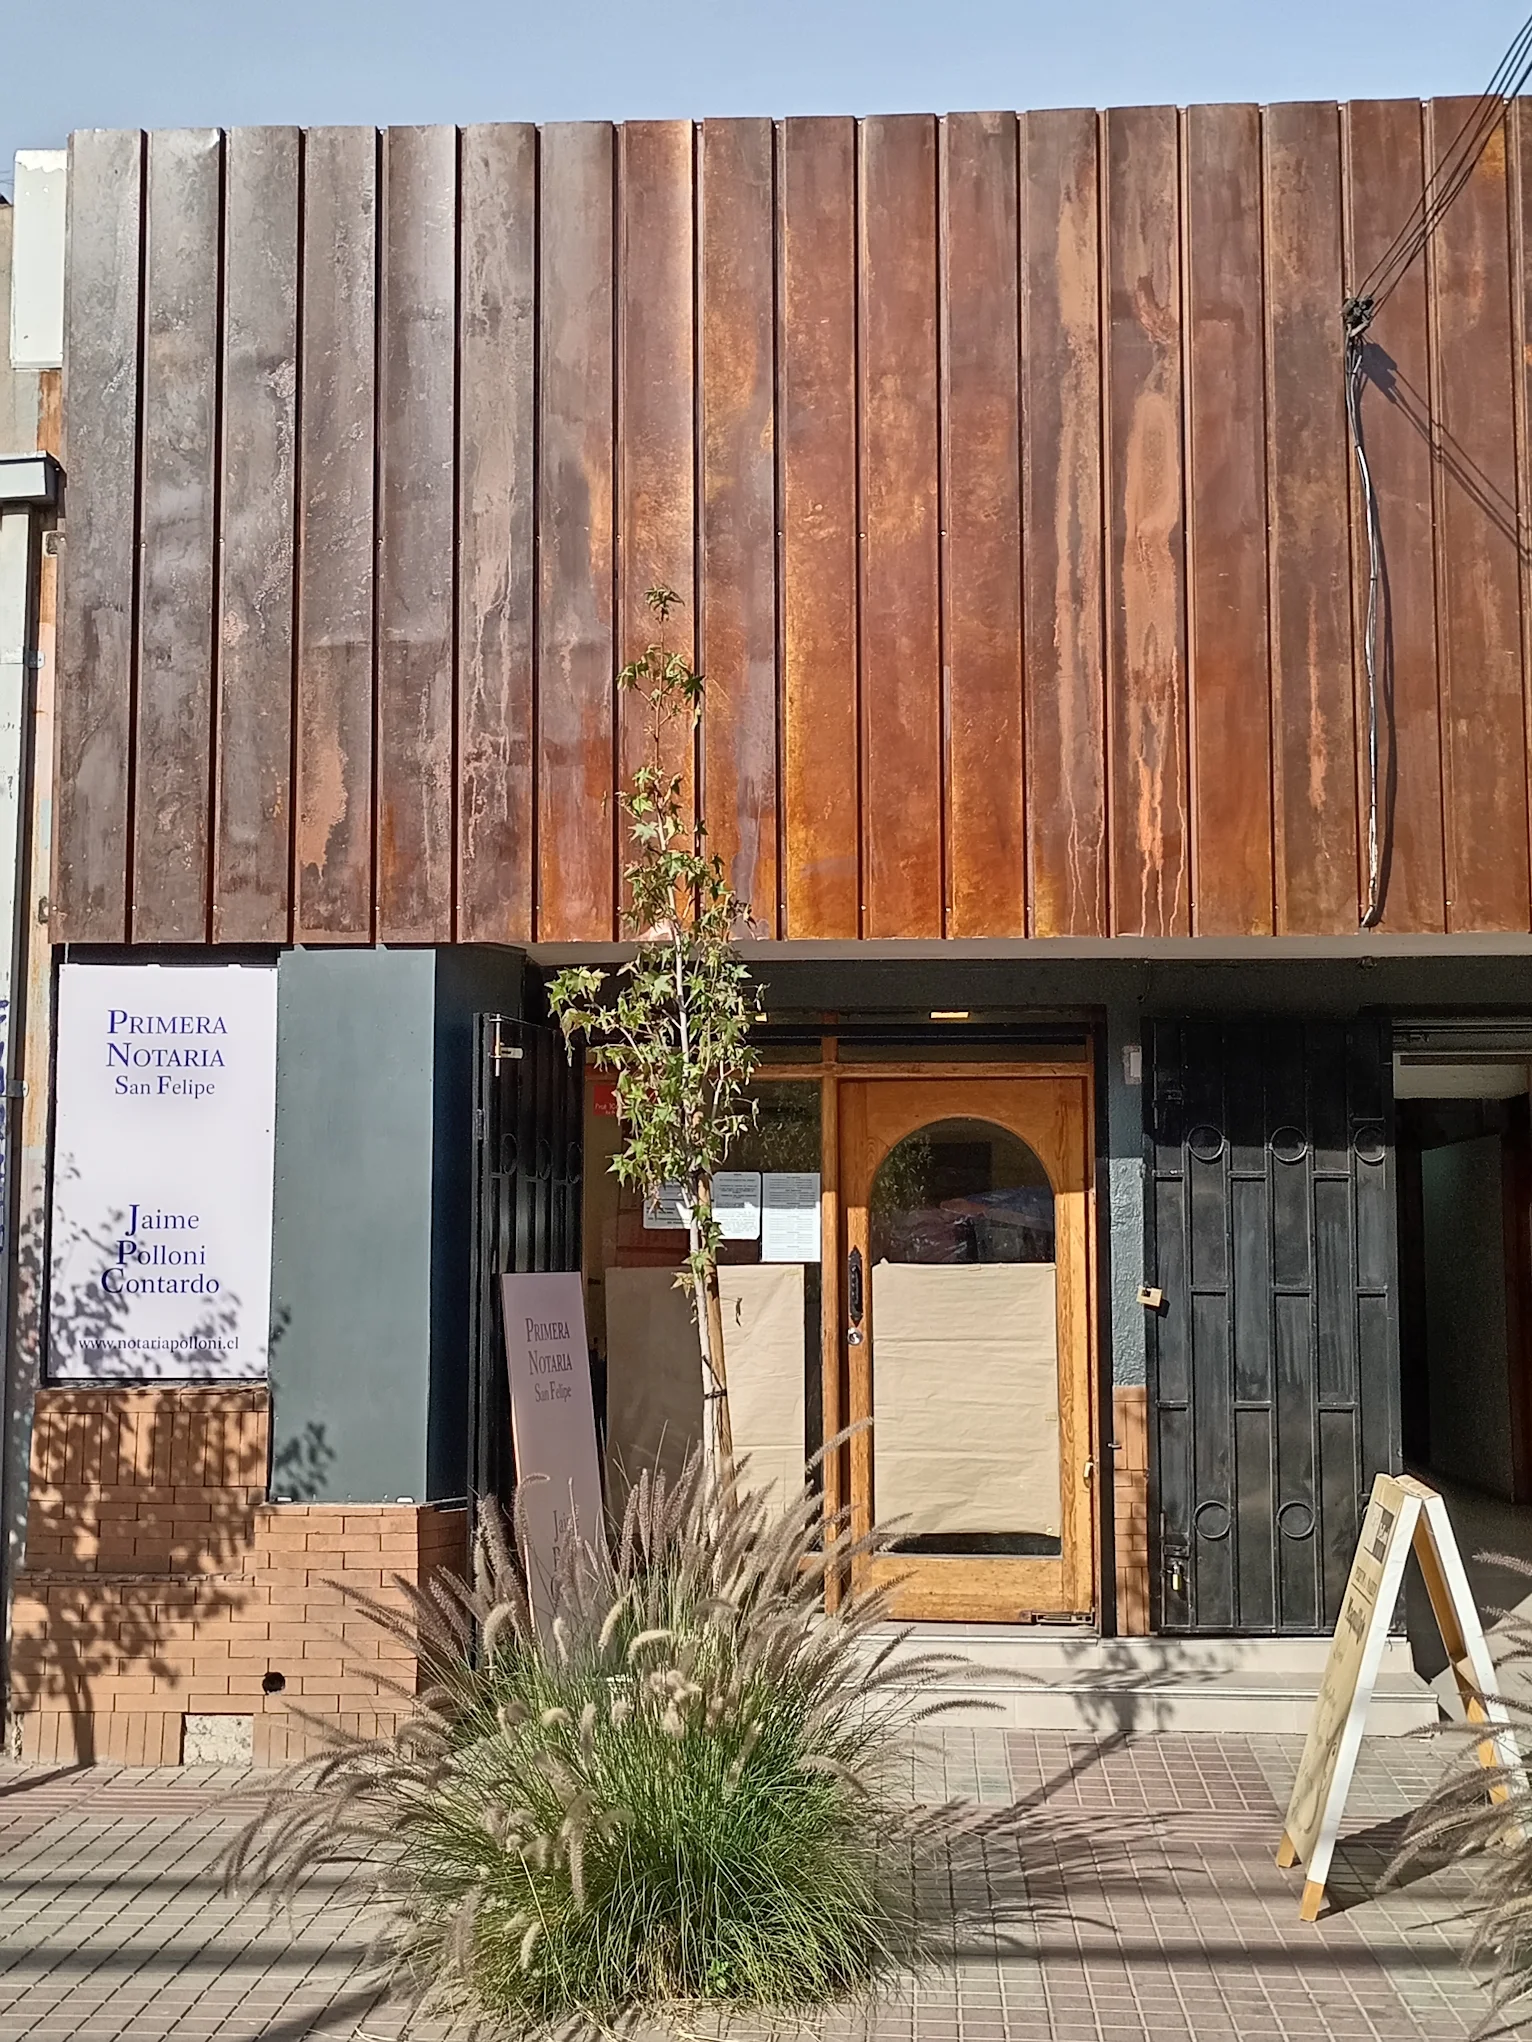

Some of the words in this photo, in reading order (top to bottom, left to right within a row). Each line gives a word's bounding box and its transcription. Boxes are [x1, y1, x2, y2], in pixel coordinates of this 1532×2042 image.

[106, 1009, 228, 1035] PRIMERA
[106, 1042, 225, 1067] NOTARIA
[115, 1075, 151, 1095] San
[157, 1075, 215, 1099] Felipe
[125, 1204, 200, 1237] Jaime
[115, 1240, 206, 1265] Polloni
[101, 1267, 220, 1294] Contardo
[525, 1317, 570, 1342] PRIMERA
[78, 1336, 239, 1353] www.notariapolloni.cl
[528, 1350, 573, 1375] NOTARIA
[534, 1383, 550, 1402] San
[549, 1381, 572, 1402] Felipe
